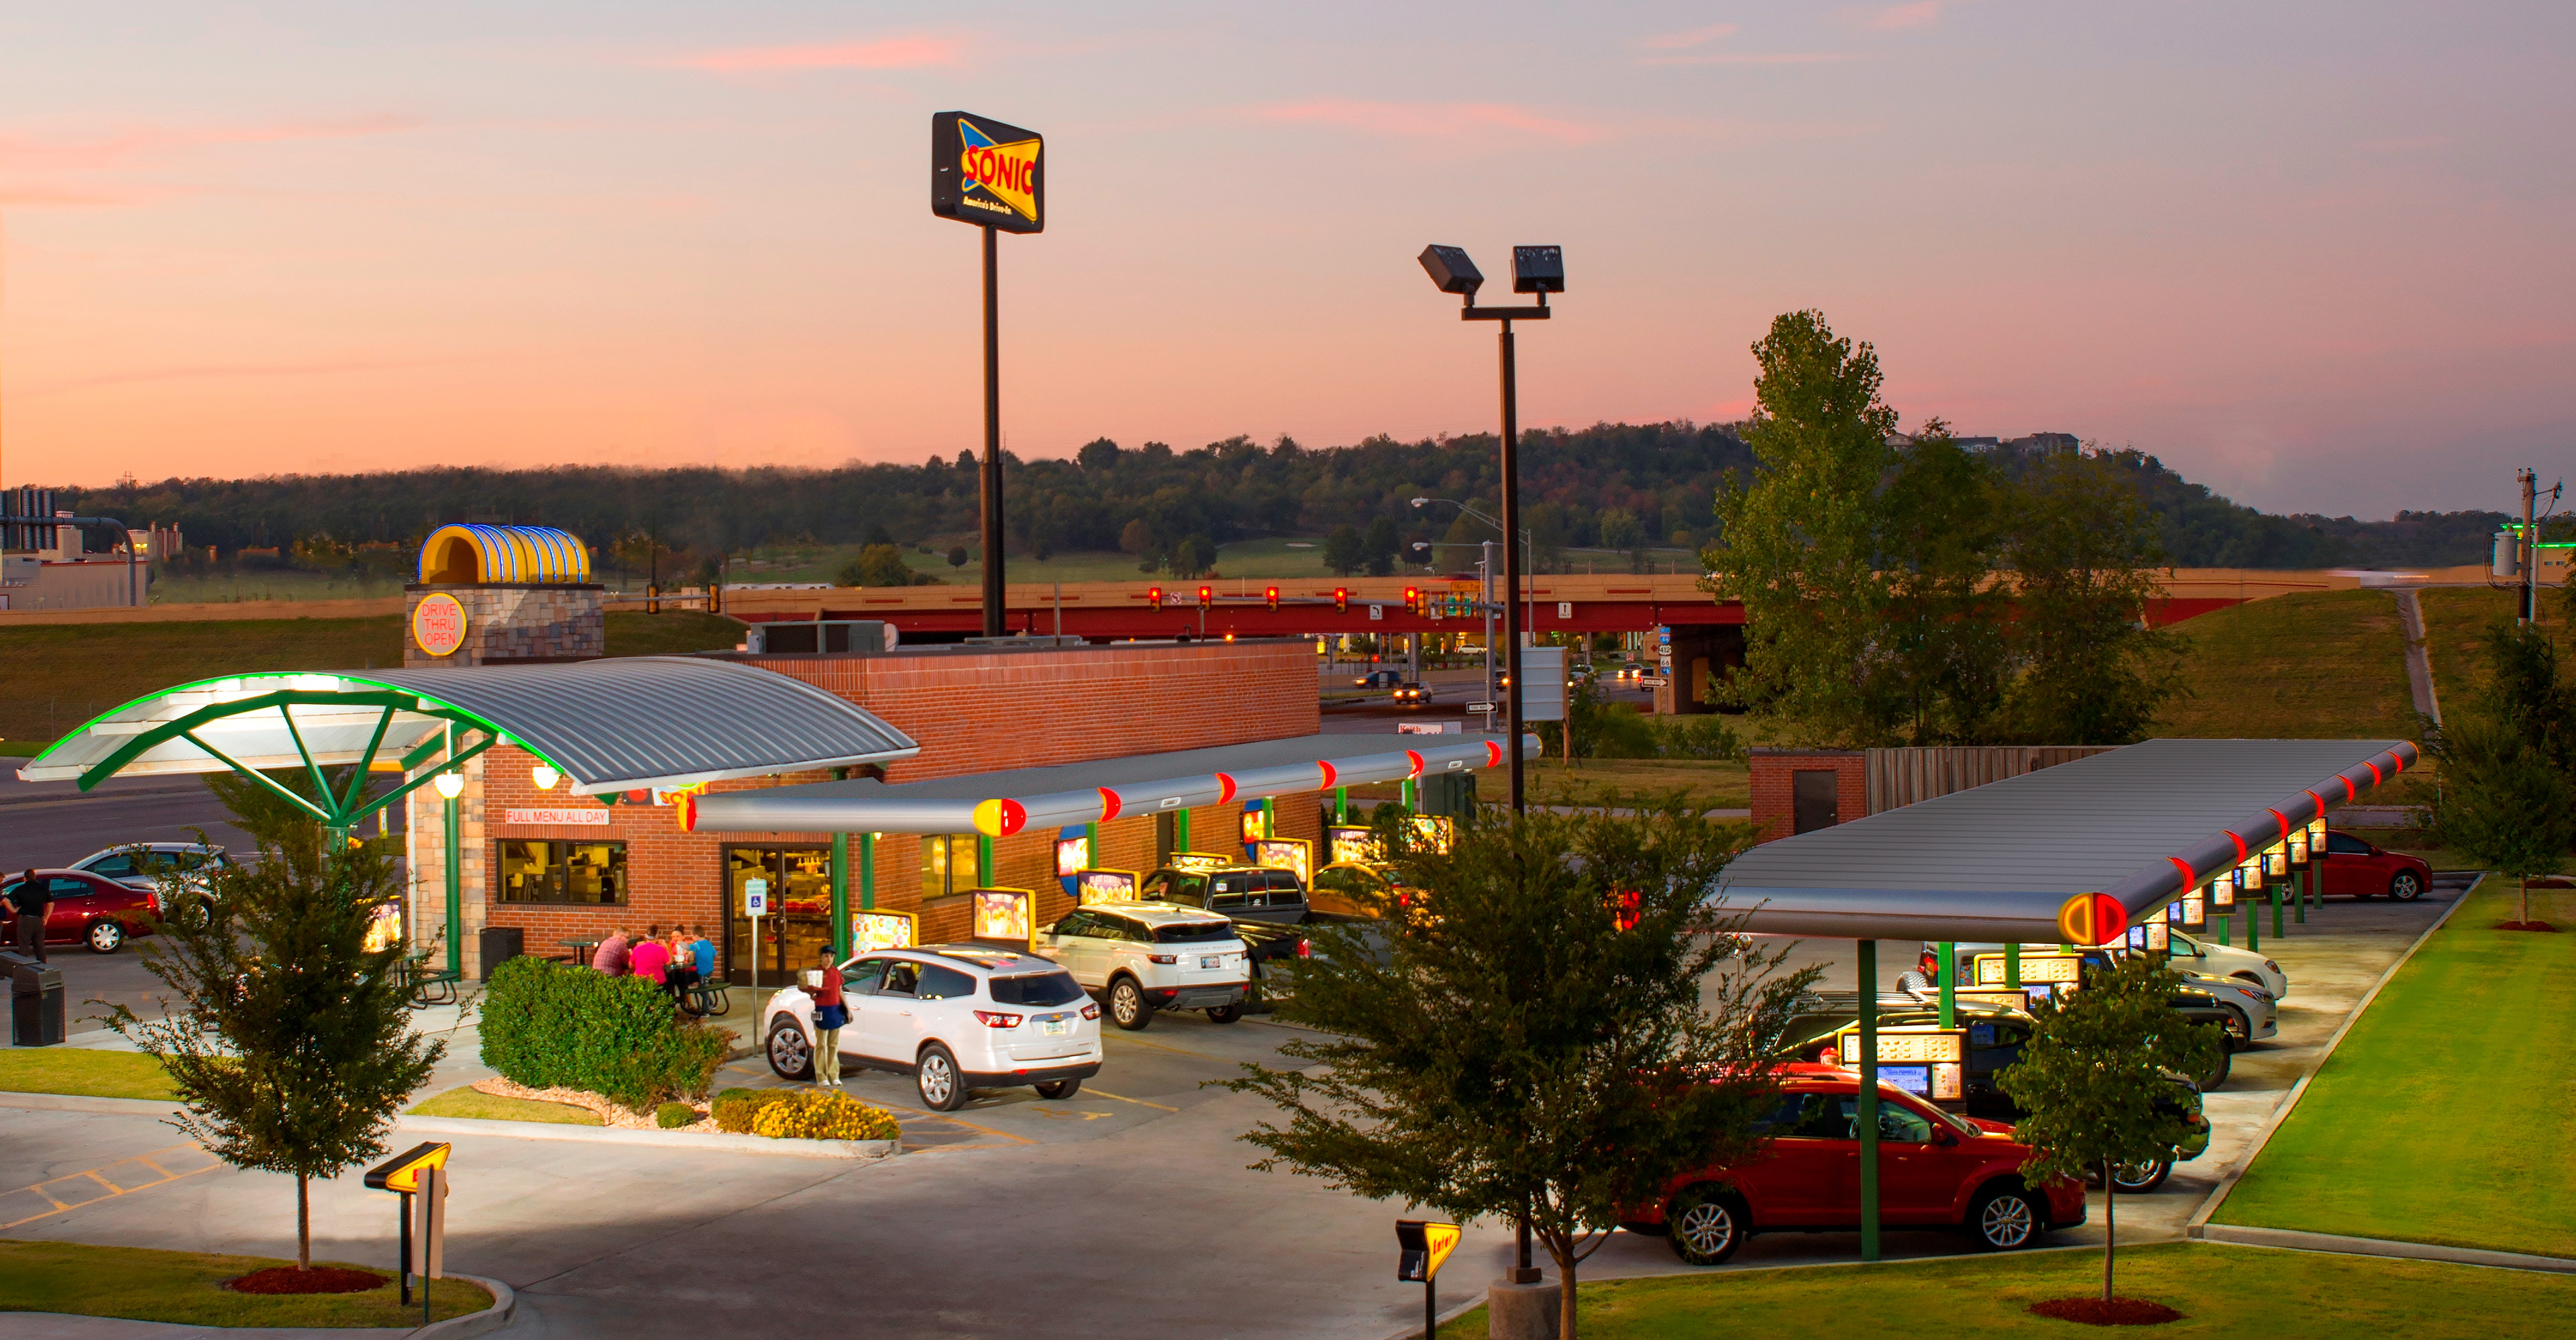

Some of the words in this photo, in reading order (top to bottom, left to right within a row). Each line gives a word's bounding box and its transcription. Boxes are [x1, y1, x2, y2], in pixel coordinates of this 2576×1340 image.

[965, 144, 1035, 195] SONIC
[963, 195, 989, 209] America's
[422, 603, 456, 616] DRIVE
[425, 618, 455, 630] THRU
[424, 632, 455, 646] OPEN
[507, 811, 531, 822] FULL
[533, 811, 564, 822] MENU
[566, 811, 584, 823] ALL
[586, 812, 606, 823] DAY
[1433, 1233, 1452, 1255] Enter
